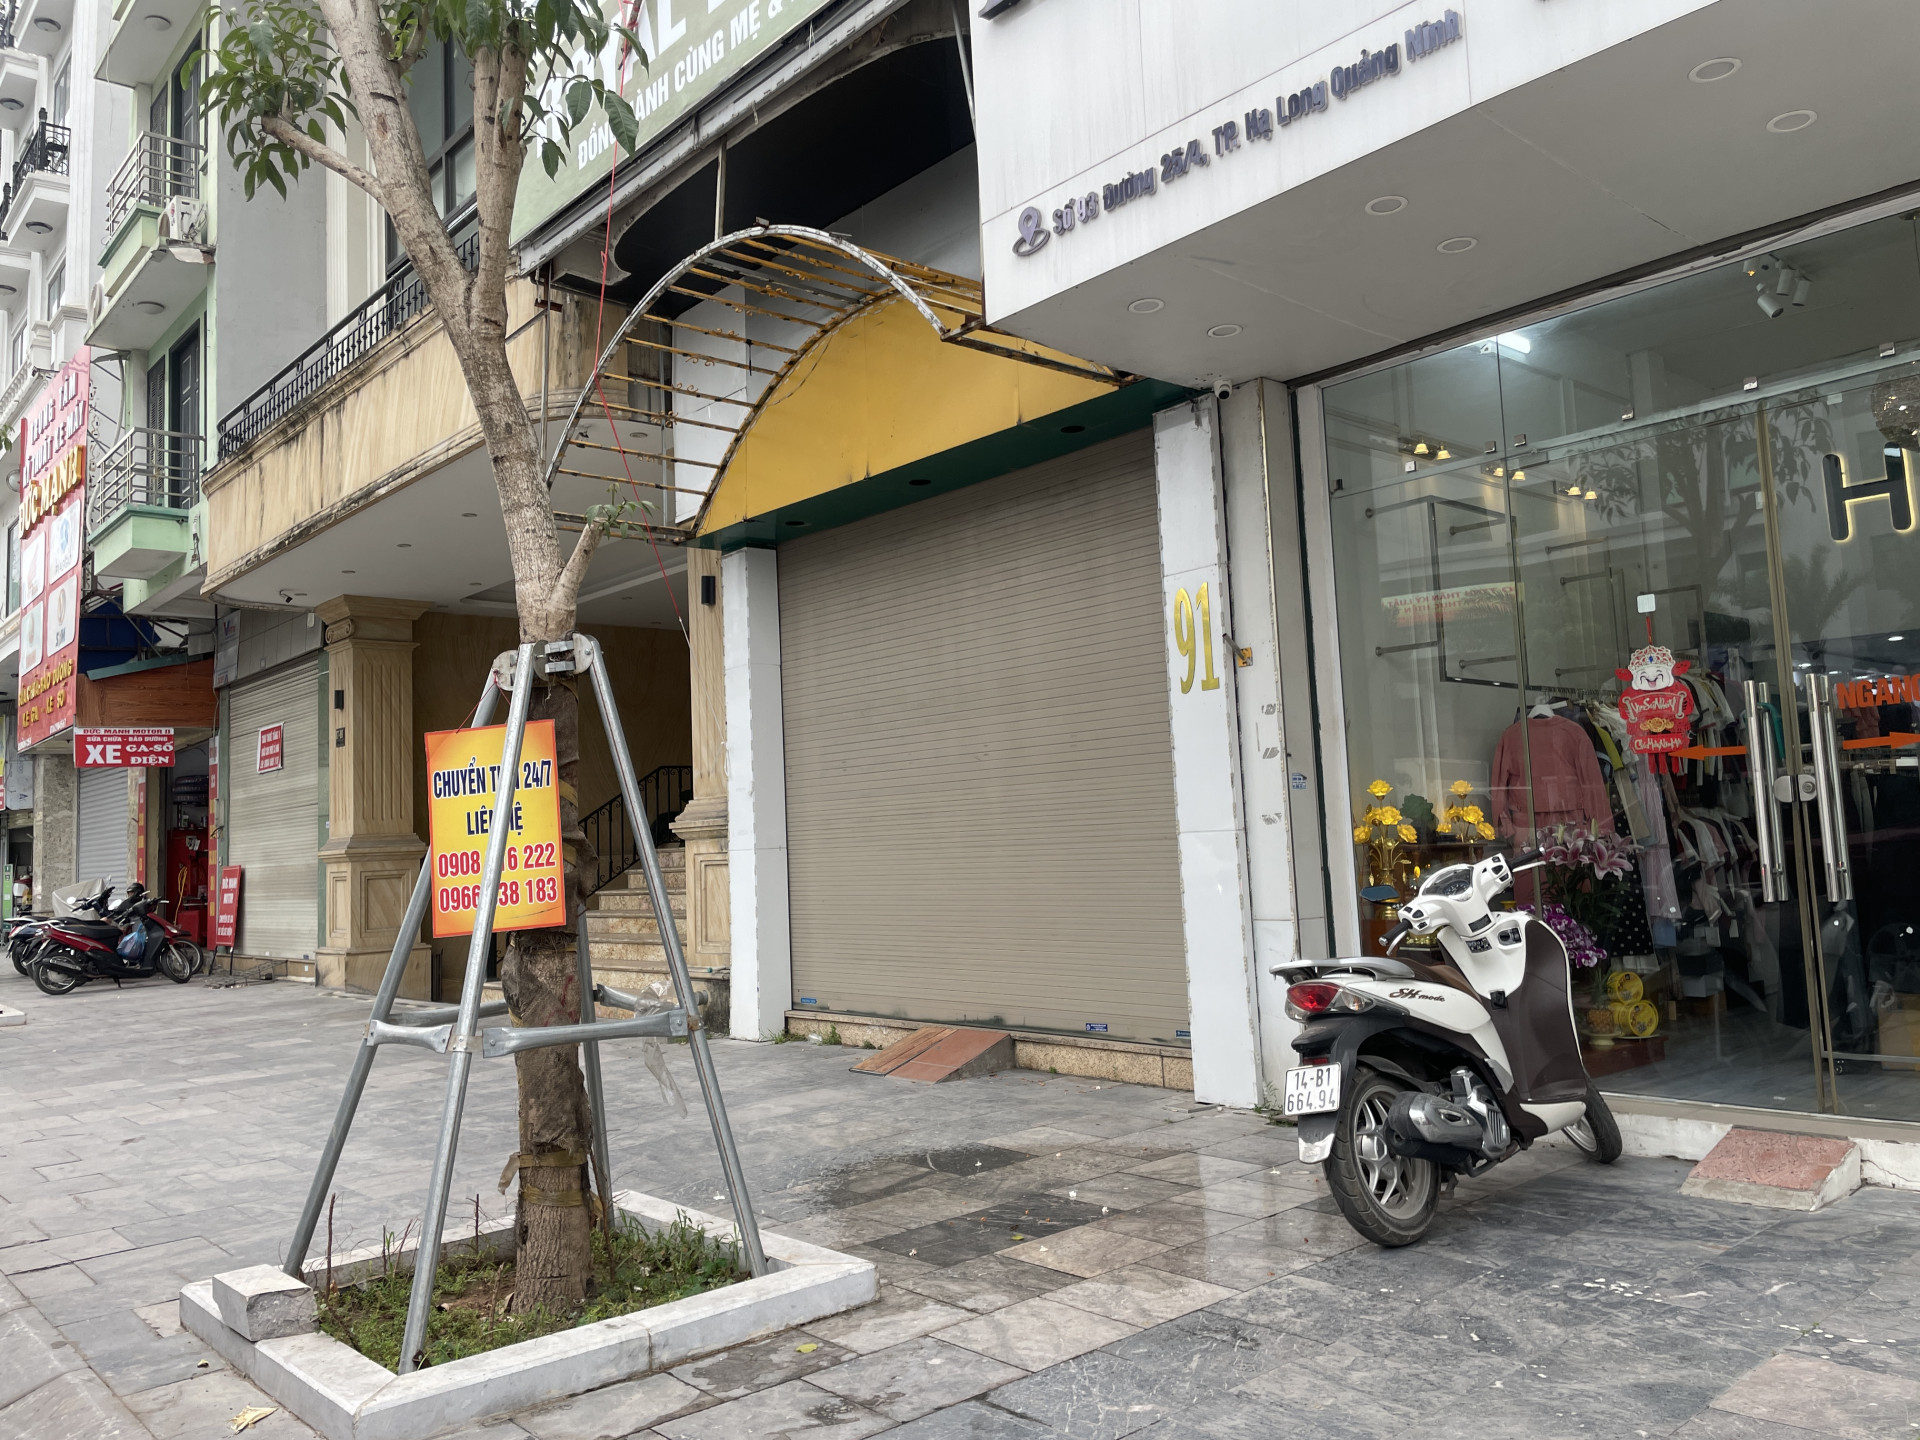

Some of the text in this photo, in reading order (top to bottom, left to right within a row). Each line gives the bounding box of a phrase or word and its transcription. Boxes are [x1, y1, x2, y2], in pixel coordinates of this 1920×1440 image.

[630, 73, 669, 121] ÀNH
[674, 33, 725, 90] CÙNG
[730, 1, 761, 50] MẸ
[1053, 9, 1462, 236] Số 93 Đường 25/4, TP. Hạ Long Quảng Ninh
[18, 445, 83, 539] ĐỨC MẠNH
[1174, 581, 1219, 694] 91
[85, 741, 174, 764] XE GA-SỐ
[130, 754, 169, 766] ĐIỆN
[433, 757, 485, 799] CHUYỂN
[523, 759, 552, 789] 24/7
[438, 850, 481, 878] 0908
[523, 842, 556, 869] 222
[439, 877, 557, 912] 0966 38 183
[1418, 993, 1446, 1003] mode
[1294, 1067, 1331, 1090] 14-B1
[1287, 1089, 1336, 1113] 664.94
